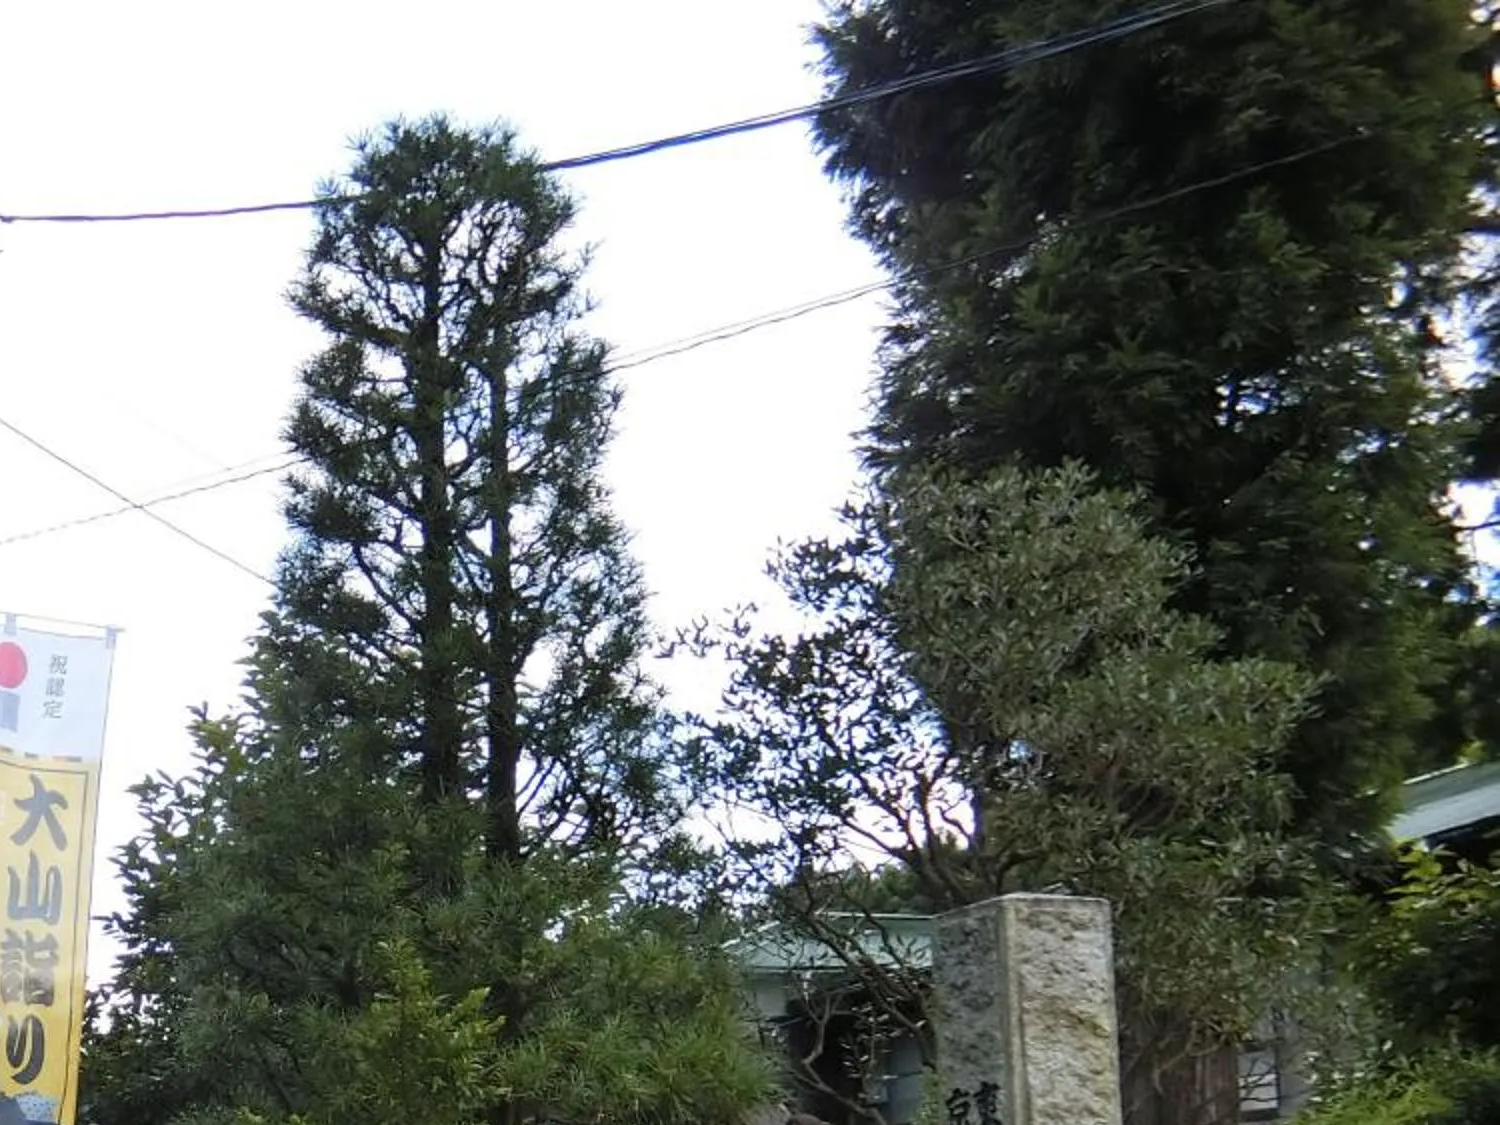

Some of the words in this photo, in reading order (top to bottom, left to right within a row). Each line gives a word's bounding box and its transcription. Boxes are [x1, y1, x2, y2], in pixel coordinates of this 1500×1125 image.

[41, 653, 70, 721] 祝認定
[0, 773, 70, 1086] 大山詣り
